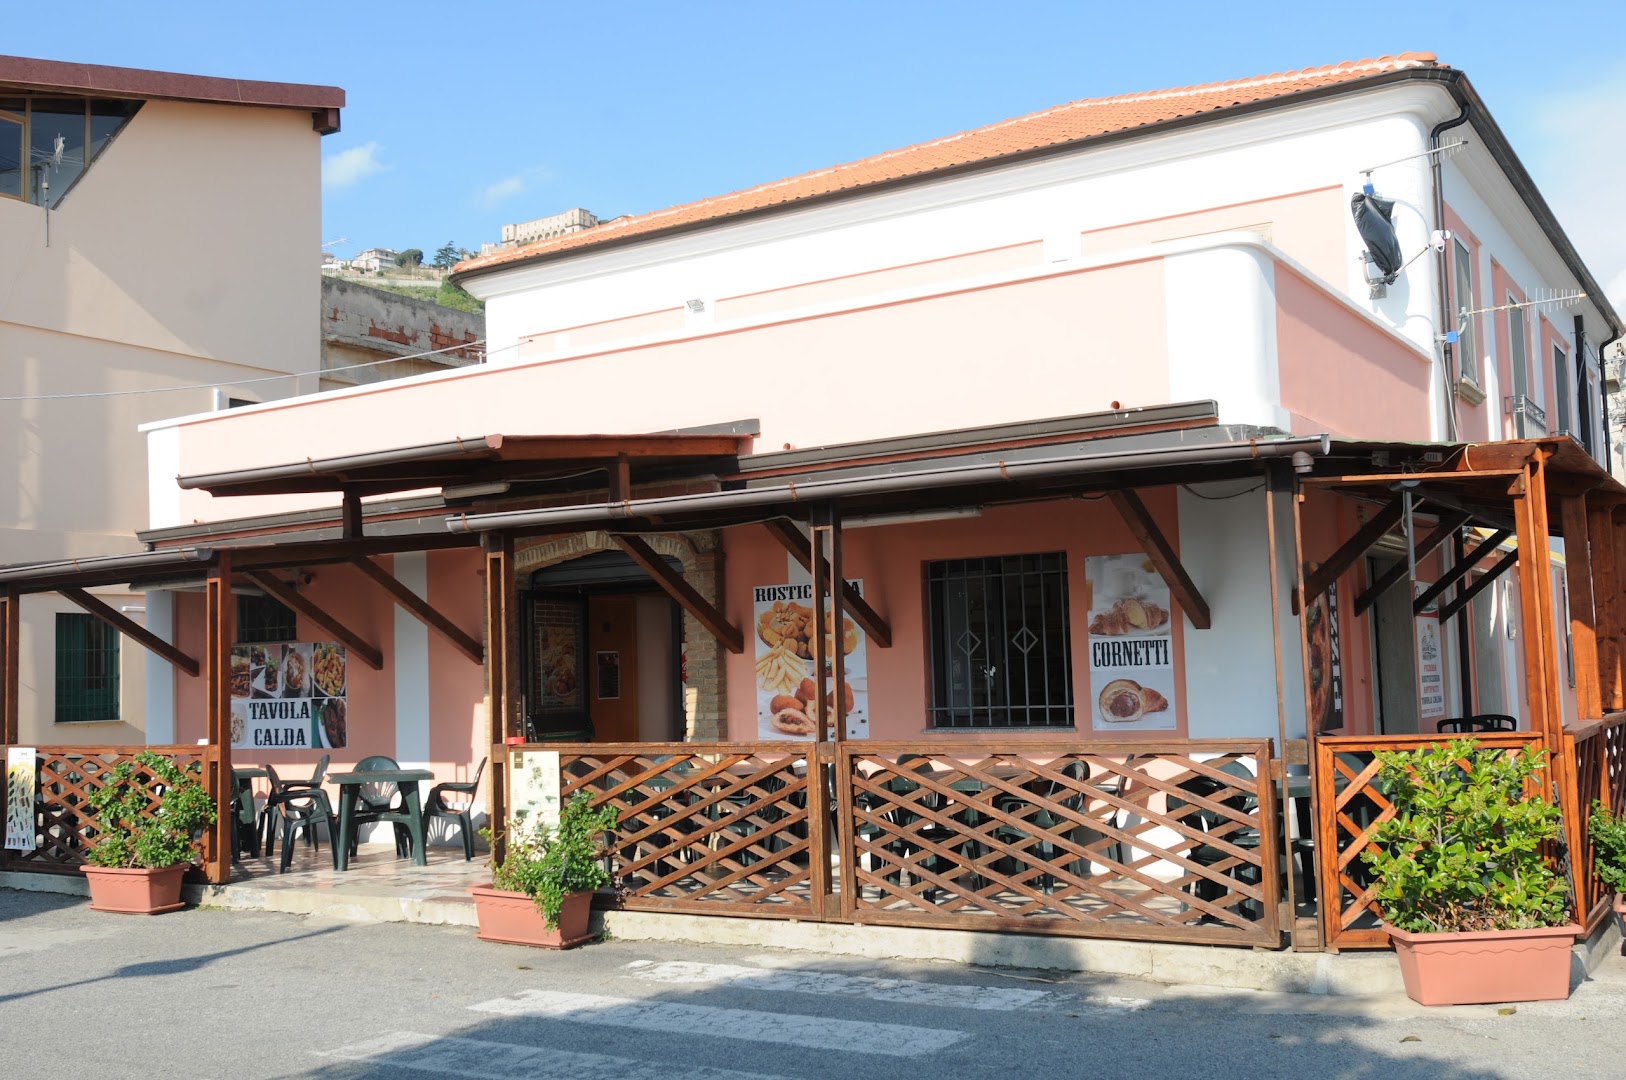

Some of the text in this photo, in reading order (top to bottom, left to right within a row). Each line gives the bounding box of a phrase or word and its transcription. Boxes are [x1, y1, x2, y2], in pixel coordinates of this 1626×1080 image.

[755, 581, 861, 602] ROSTICA
[1093, 639, 1169, 668] CORNETTI
[249, 701, 311, 720] TAVOLA
[254, 728, 307, 746] CALDA
